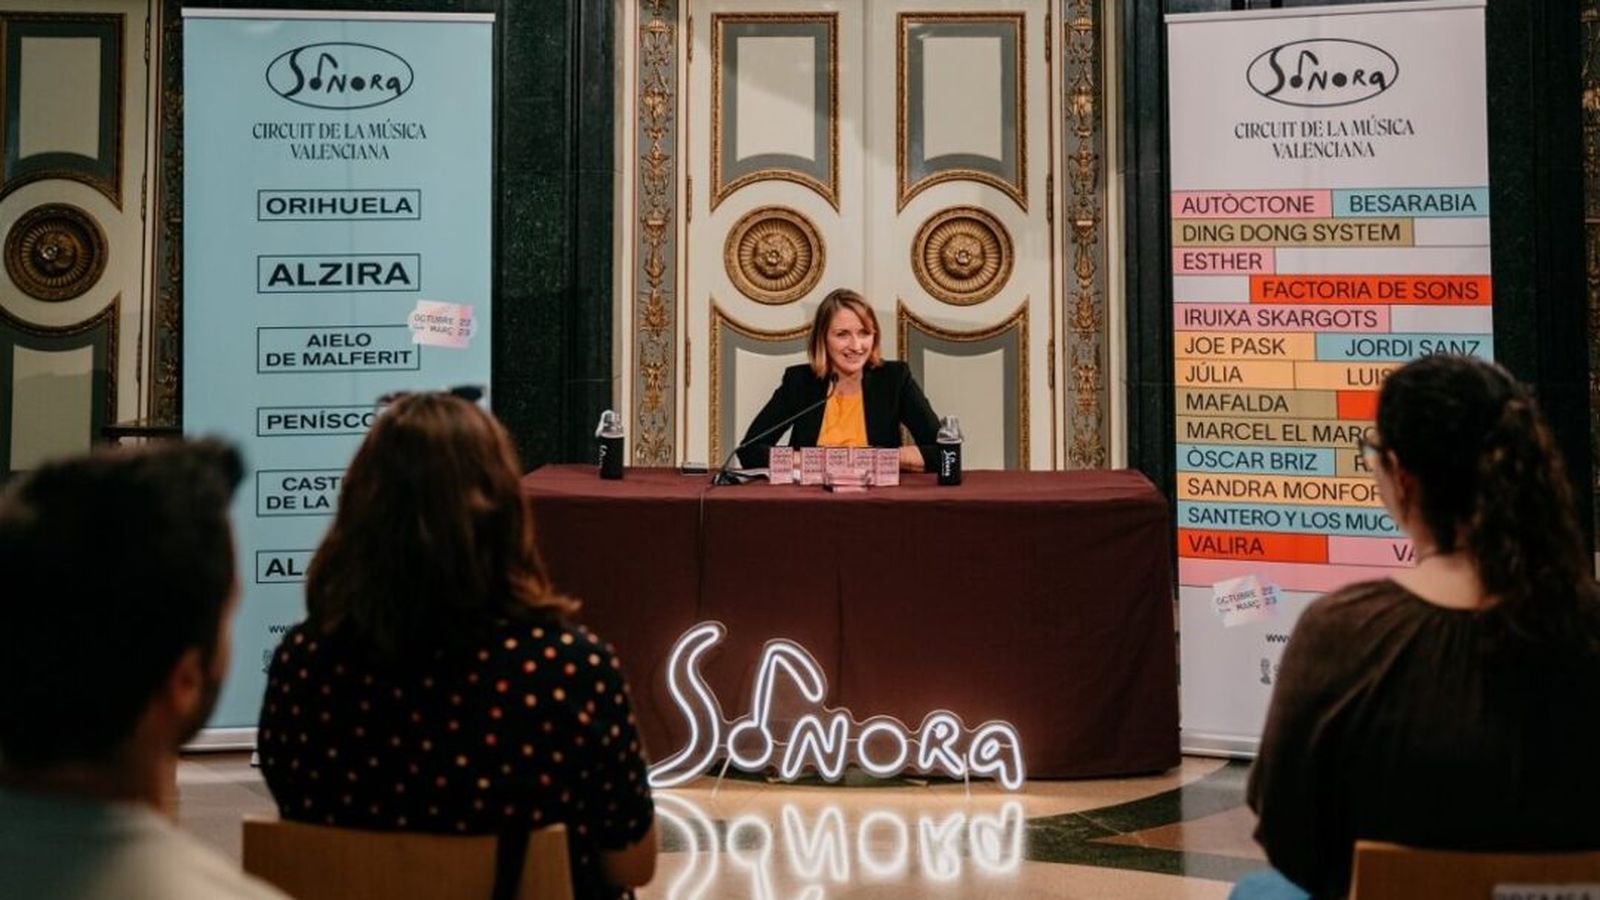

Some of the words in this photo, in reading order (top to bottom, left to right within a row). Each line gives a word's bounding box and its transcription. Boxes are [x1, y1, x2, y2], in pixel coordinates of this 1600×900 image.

[252, 122, 315, 140] CIRCUIT
[319, 123, 341, 140] DE
[344, 123, 365, 140] LA
[368, 118, 427, 140] MÚSICA
[1234, 121, 1297, 139] CIRCUIT
[1301, 120, 1323, 138] DE
[1327, 120, 1348, 137] LA
[1351, 114, 1415, 136] MÚSICA
[290, 143, 389, 160] VALENCIANA
[1272, 140, 1375, 159] VALENCIANA
[265, 197, 413, 215] ORIHUELA
[1182, 193, 1315, 214] AUTÒCTONE
[1349, 194, 1477, 213] BESARABIA
[1182, 225, 1235, 242] DING
[1240, 224, 1307, 242] DONG
[1312, 223, 1401, 241] SYSTEM
[1183, 252, 1263, 270] ESTHER
[267, 262, 411, 287] ALZIRA
[1262, 281, 1373, 299] FACTORIA
[1378, 281, 1407, 298] DE
[1412, 280, 1480, 300] SONS
[1184, 308, 1252, 326] IRUIXA
[1257, 309, 1378, 328] SKARGOTS
[307, 333, 371, 347] AIELO
[1184, 337, 1226, 355] JOE
[1231, 338, 1287, 355] PASK
[1345, 338, 1413, 357] JORDI
[1419, 340, 1481, 357] SANZ
[266, 352, 297, 367] DE
[303, 350, 412, 366] MALFERIT
[1185, 362, 1244, 384] JÚLIA
[1186, 394, 1289, 413] MAFALDA
[1186, 422, 1278, 441] MARCEL
[1282, 424, 1307, 442] EL
[1187, 445, 1264, 469] ÒSCAR
[1270, 450, 1319, 471] BRIZ
[282, 476, 345, 491] CAST
[1187, 477, 1276, 498] SANDRA
[266, 495, 297, 510] DE
[303, 495, 330, 509] LA
[1188, 507, 1280, 526] SANTERO
[1285, 512, 1298, 529] Y
[1301, 511, 1341, 530] LOS
[1346, 513, 1400, 532] MUC
[1189, 536, 1264, 554] VALIRA
[265, 557, 309, 577] AL
